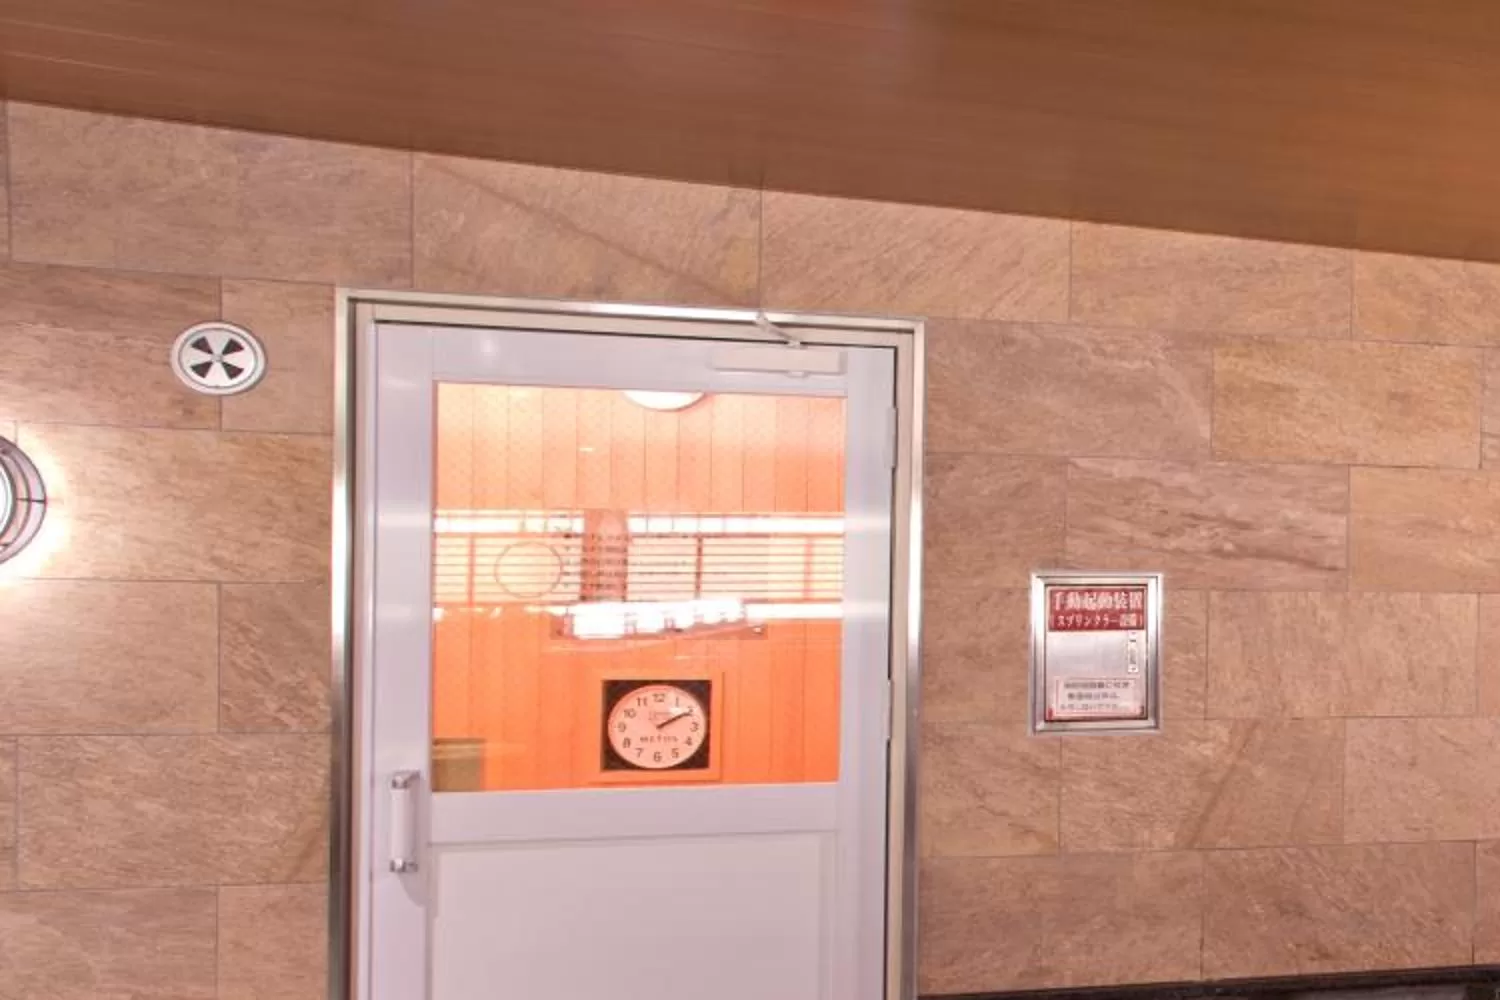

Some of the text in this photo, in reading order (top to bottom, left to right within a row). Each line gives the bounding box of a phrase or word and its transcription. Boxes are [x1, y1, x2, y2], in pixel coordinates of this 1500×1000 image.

[636, 696, 648, 707] 11
[652, 693, 666, 703] 12
[623, 708, 637, 718] 10
[617, 722, 627, 733] 9
[689, 721, 699, 732] 3
[622, 737, 631, 748] 8
[684, 736, 693, 746] 4
[635, 747, 644, 758] 7
[653, 751, 662, 763] 6
[671, 747, 680, 759] 5
